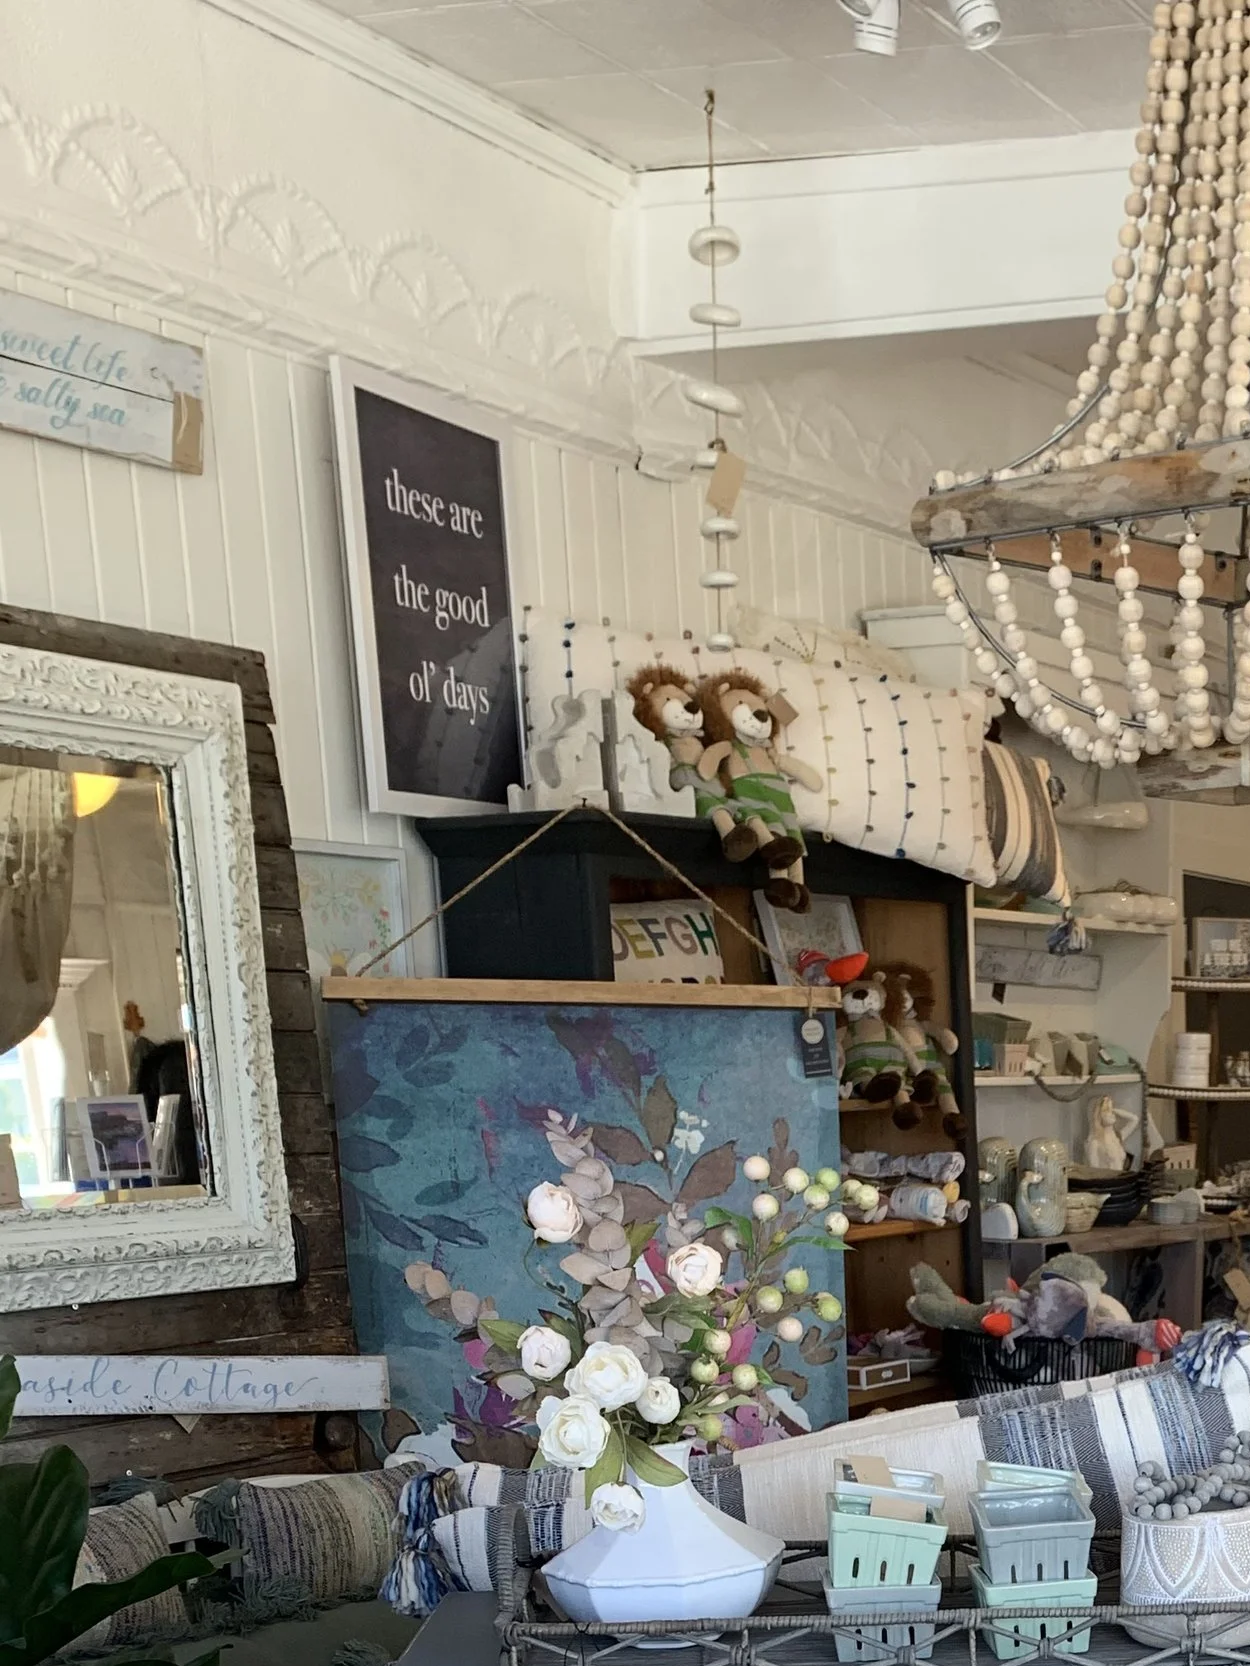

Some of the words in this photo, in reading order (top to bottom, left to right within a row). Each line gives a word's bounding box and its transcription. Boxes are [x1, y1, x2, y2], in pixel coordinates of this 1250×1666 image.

[1, 330, 81, 371] sweet
[83, 342, 128, 389] life
[15, 377, 84, 430] salty
[87, 402, 126, 426] sea
[385, 467, 445, 526] these
[449, 503, 483, 539] are
[394, 564, 430, 612] the
[435, 586, 490, 630] good
[409, 660, 435, 703] ol'
[443, 666, 490, 725] days
[150, 1358, 319, 1405] Cottage
